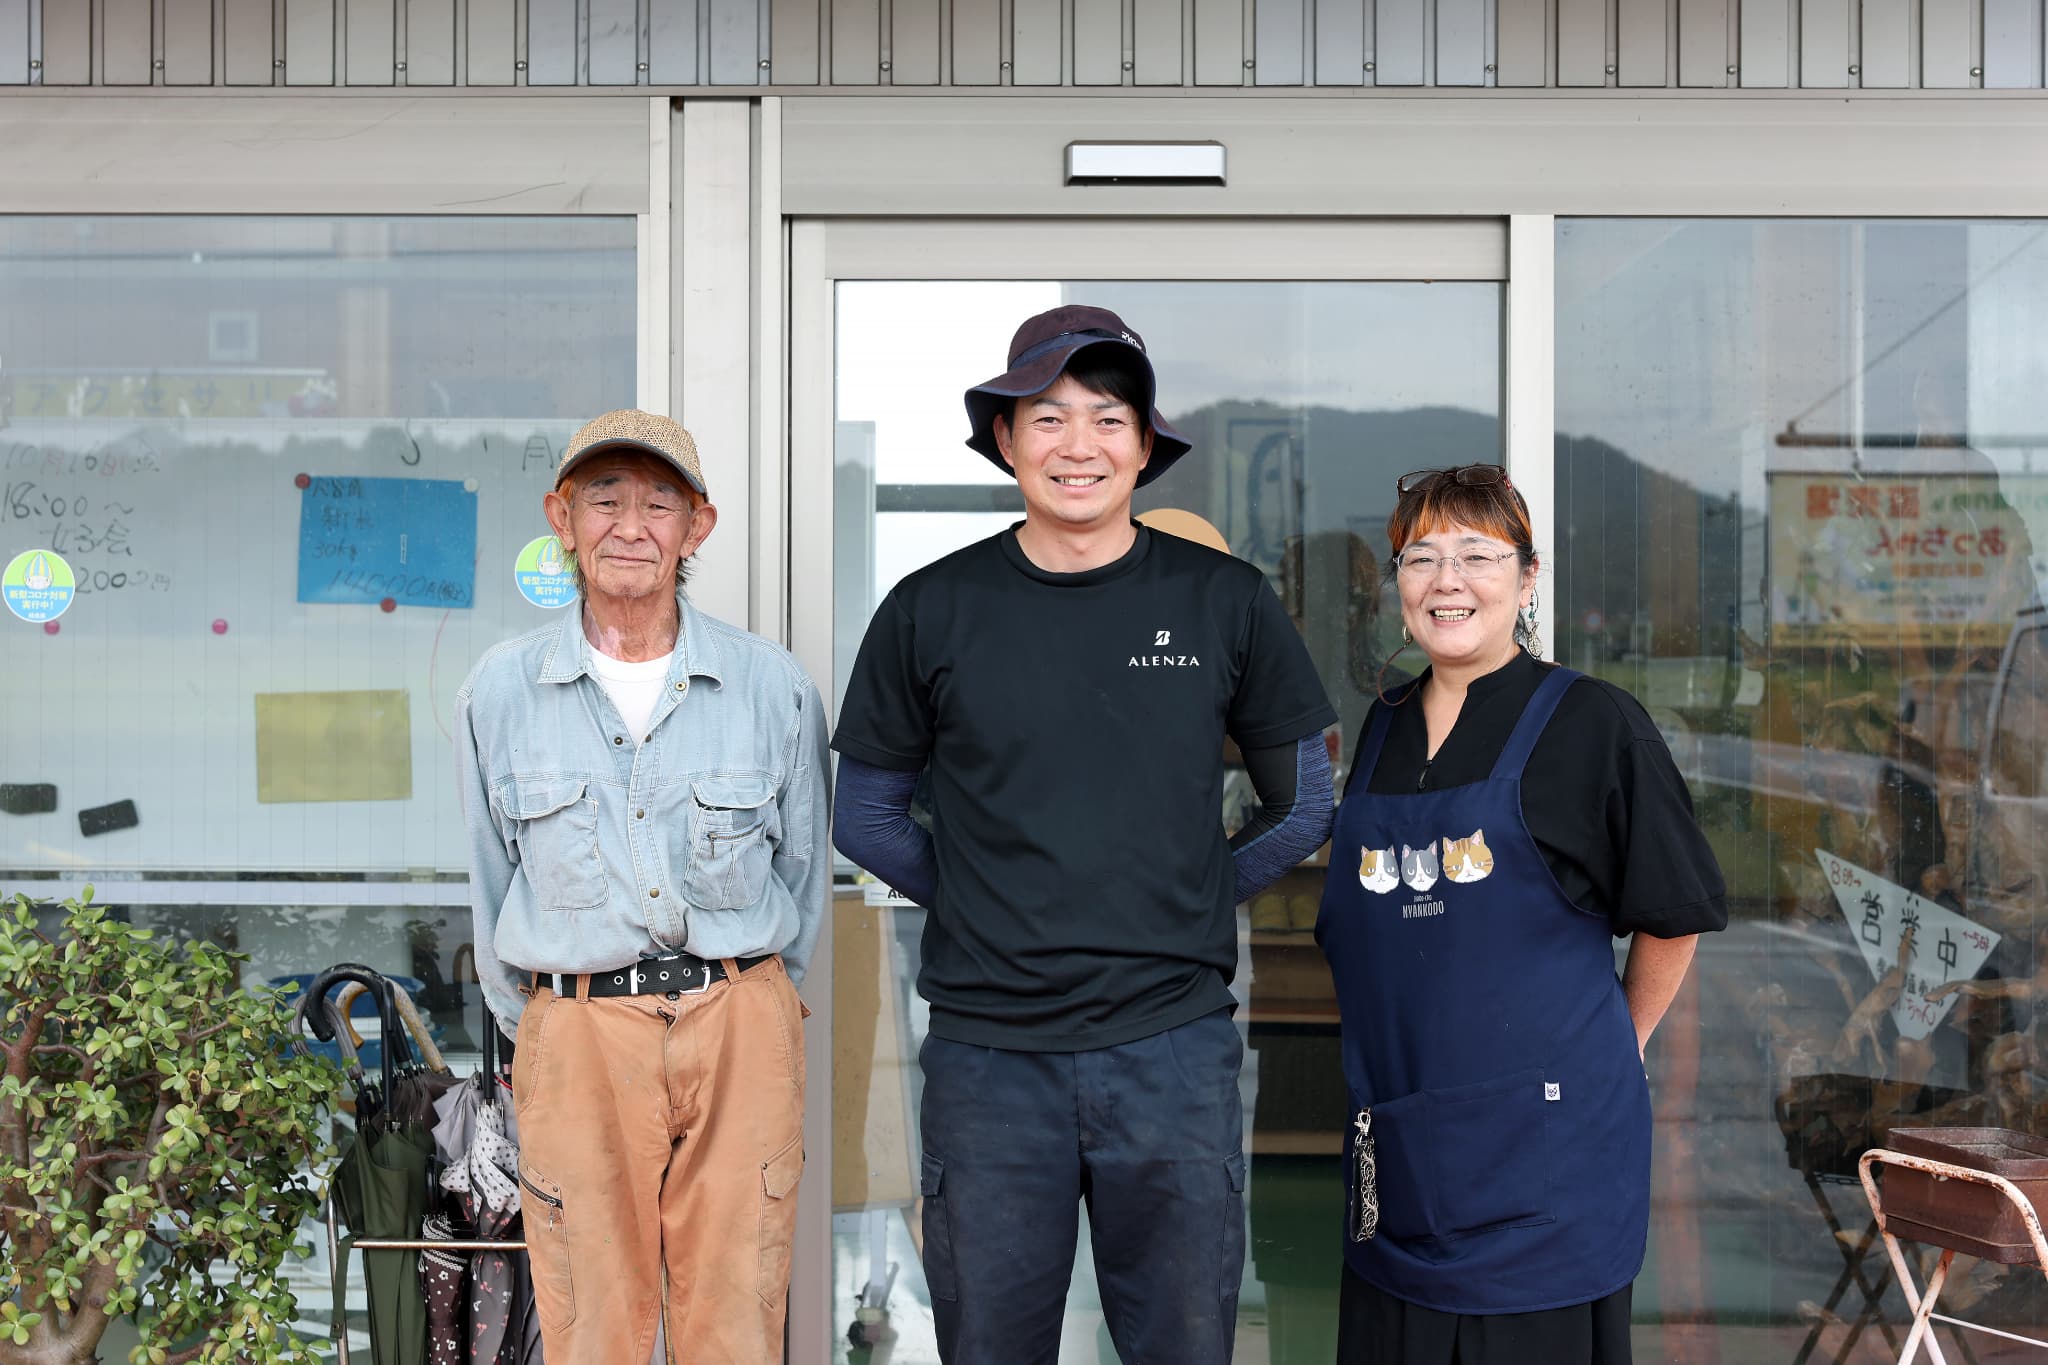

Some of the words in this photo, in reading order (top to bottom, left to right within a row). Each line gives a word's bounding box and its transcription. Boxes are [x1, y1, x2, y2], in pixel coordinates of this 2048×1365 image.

[1128, 655, 1200, 667] ALENZA
[1402, 900, 1445, 919] NYANKODO
[1861, 890, 1958, 983] 営業中
